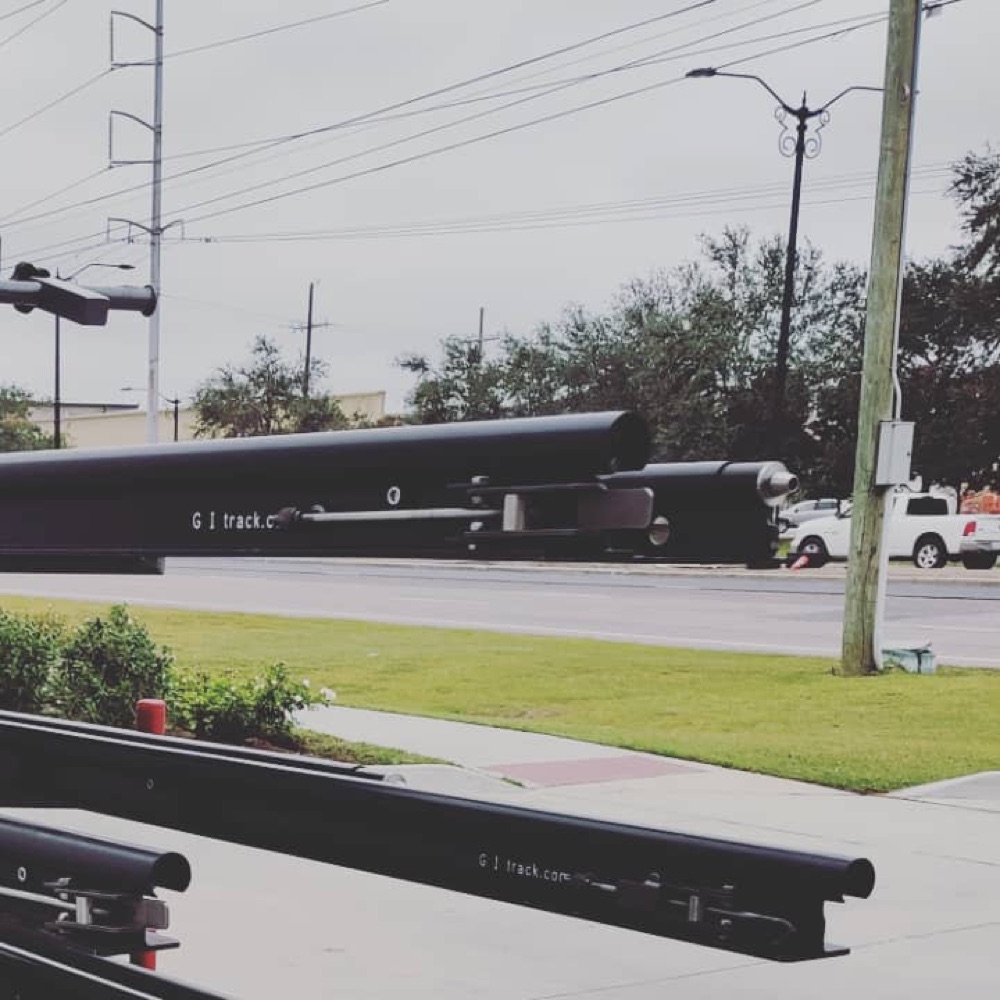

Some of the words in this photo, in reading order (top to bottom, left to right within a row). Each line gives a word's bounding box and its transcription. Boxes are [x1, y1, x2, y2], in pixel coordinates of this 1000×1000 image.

[192, 511, 201, 530] G
[223, 511, 279, 530] track.c
[479, 853, 487, 867] G
